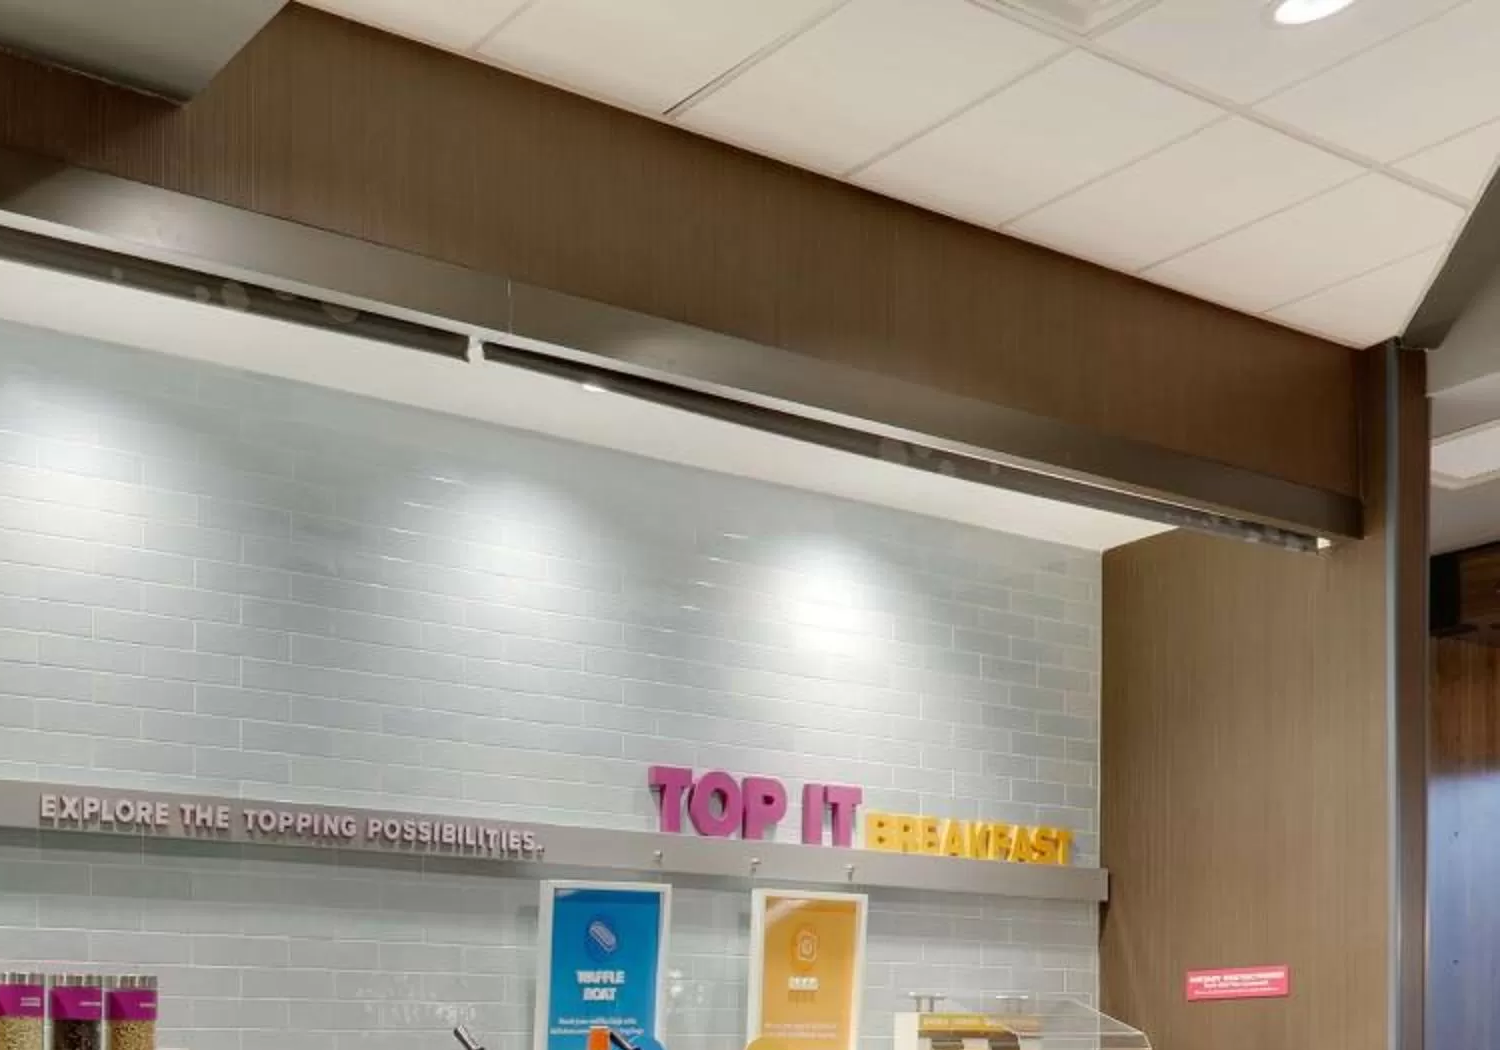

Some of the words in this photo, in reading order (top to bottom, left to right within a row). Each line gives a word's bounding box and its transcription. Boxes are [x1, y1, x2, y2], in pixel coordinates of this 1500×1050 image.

[40, 793, 170, 826] EXPLORE
[180, 803, 230, 829] THE
[244, 809, 357, 838] TOPPING
[367, 817, 546, 853] POSSIBILITIES.
[648, 765, 788, 839] TOP
[800, 783, 863, 848] IT
[866, 811, 1075, 866] BREAKFAST
[576, 970, 626, 985] WAFFLE
